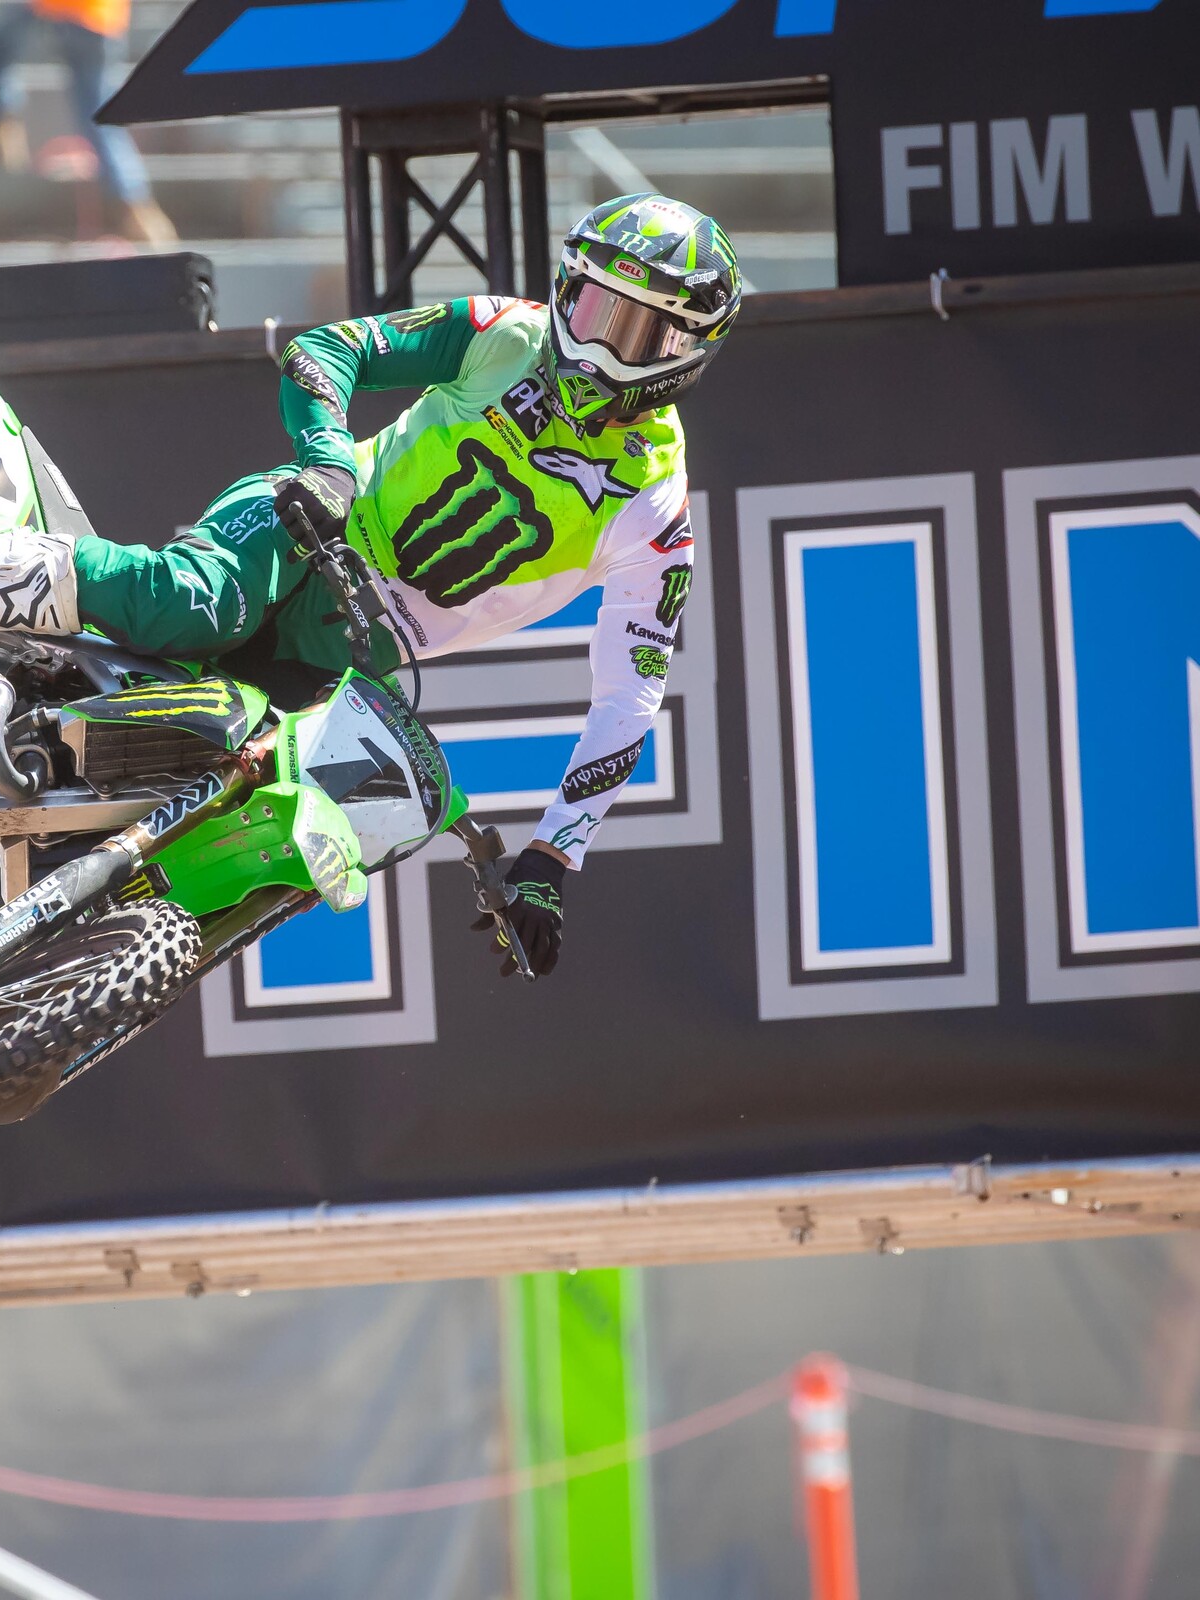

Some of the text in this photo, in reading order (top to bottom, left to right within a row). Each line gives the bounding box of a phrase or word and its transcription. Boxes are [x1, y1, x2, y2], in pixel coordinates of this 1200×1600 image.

[881, 113, 1091, 236] FIM
[618, 261, 642, 278] BELL
[499, 428, 525, 461] EQUIPMENT
[503, 424, 524, 449] HONNEN
[347, 598, 370, 628] ARC
[632, 646, 669, 662] TEAM
[638, 660, 669, 676] GREEN
[305, 737, 412, 803] 1
[395, 725, 426, 784] MONSTER
[563, 742, 642, 793] MONSTER
